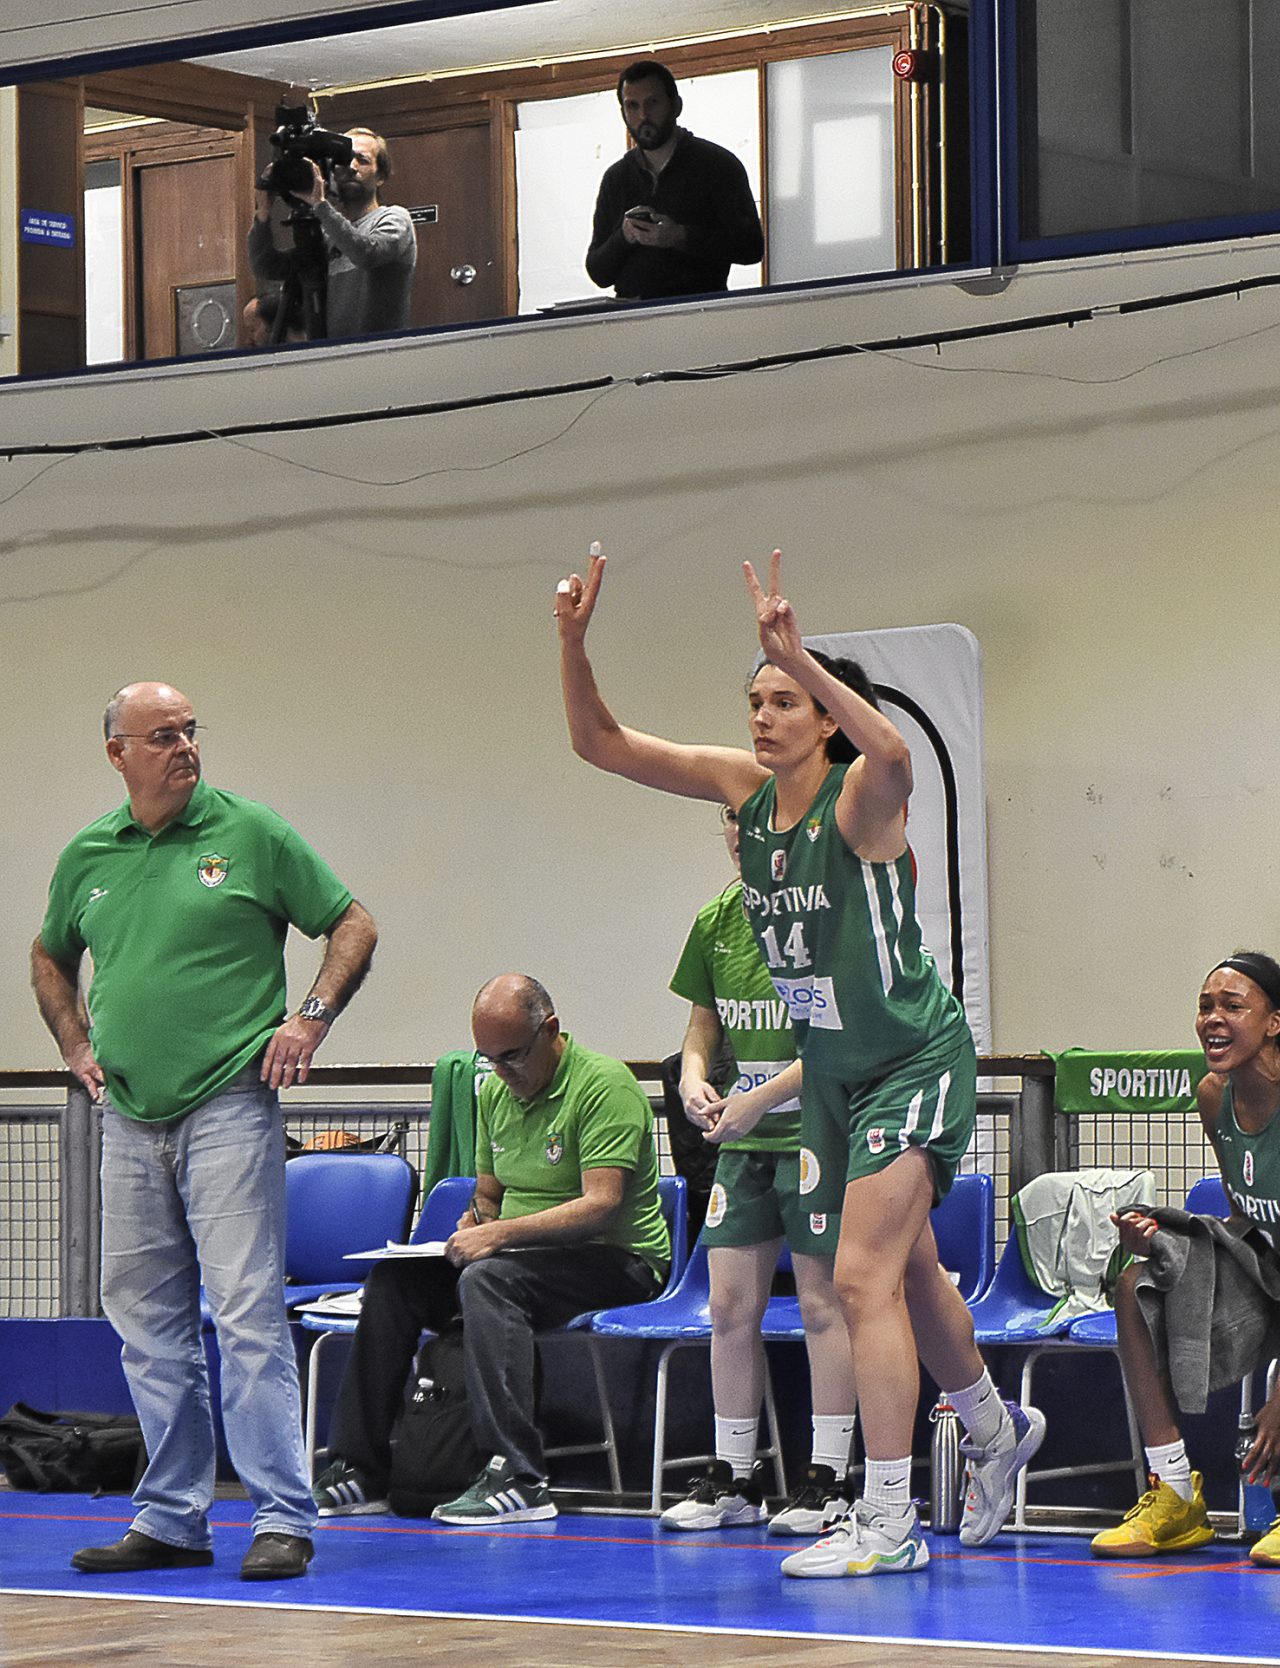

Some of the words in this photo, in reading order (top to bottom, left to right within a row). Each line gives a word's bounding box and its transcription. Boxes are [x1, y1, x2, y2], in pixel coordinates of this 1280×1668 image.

[760, 922, 813, 969] 14
[714, 996, 793, 1031] PORTIV
[1090, 1067, 1192, 1098] SPORTIVA
